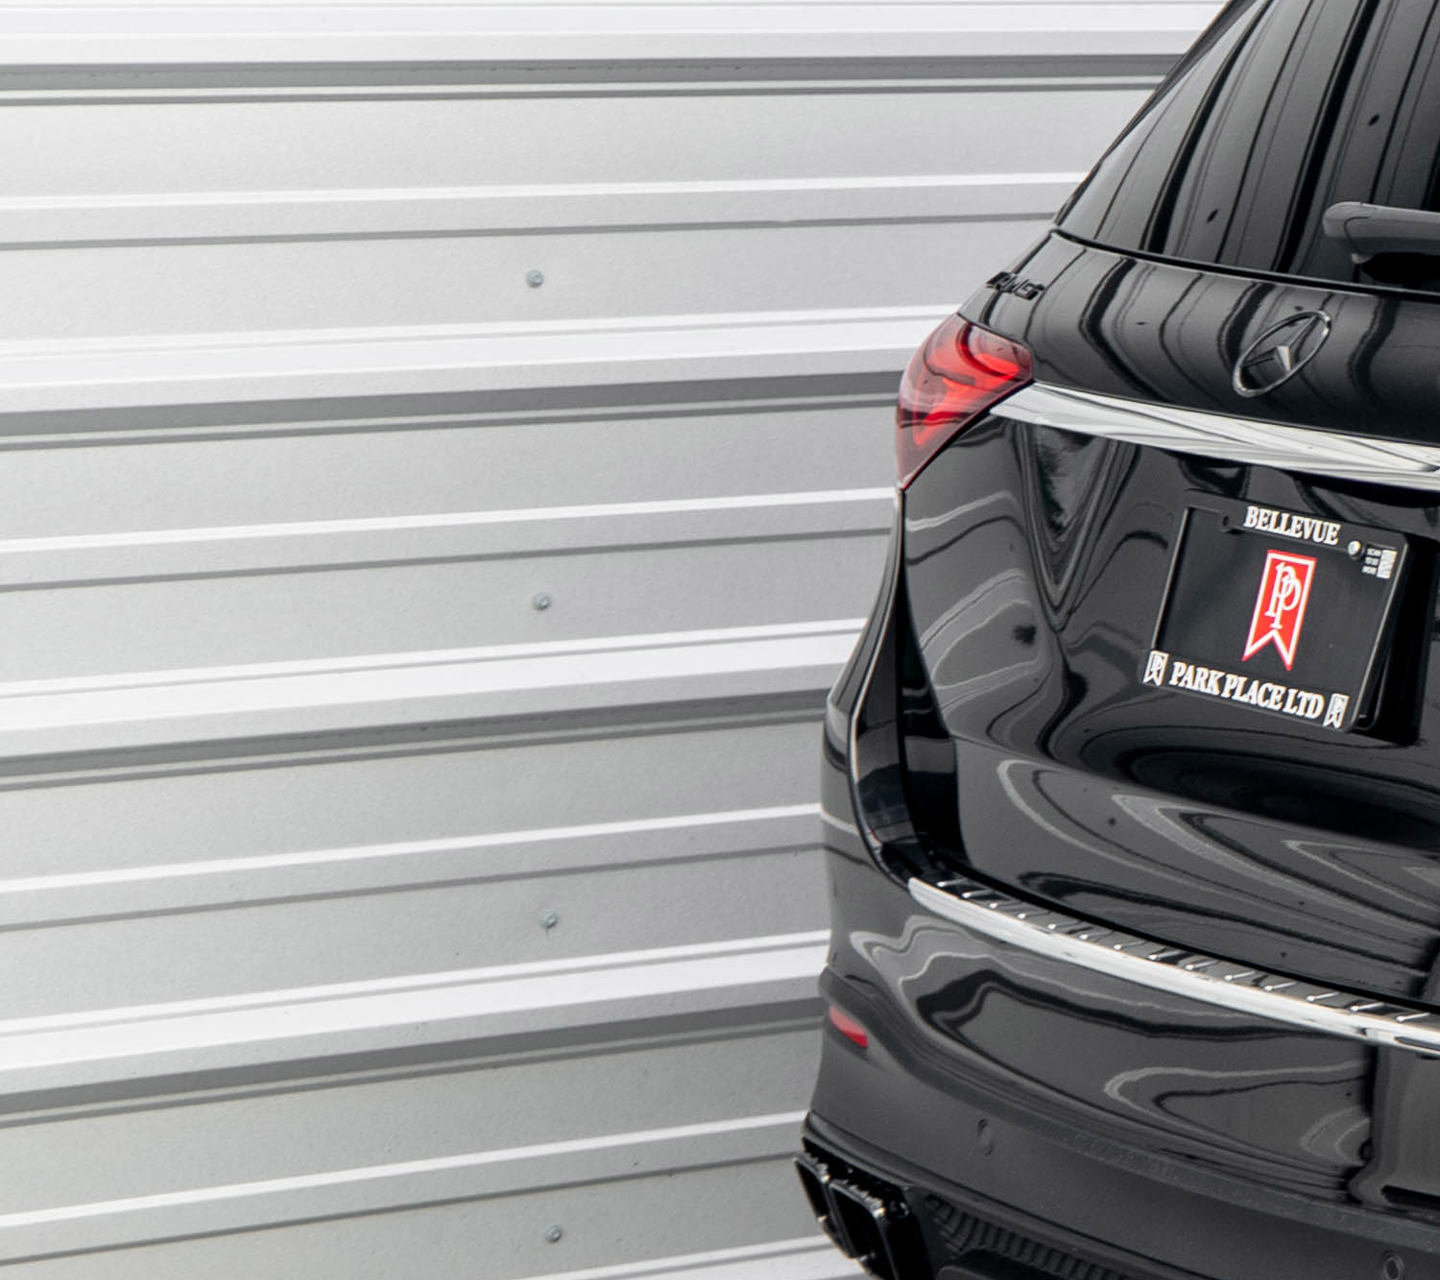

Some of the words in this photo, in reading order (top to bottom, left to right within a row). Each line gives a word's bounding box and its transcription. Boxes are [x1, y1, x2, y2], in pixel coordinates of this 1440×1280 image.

[1243, 505, 1342, 546] BELLEVUE
[1168, 661, 1220, 696] PARK
[1221, 673, 1287, 711] PLACE
[1281, 688, 1325, 719] LTD
